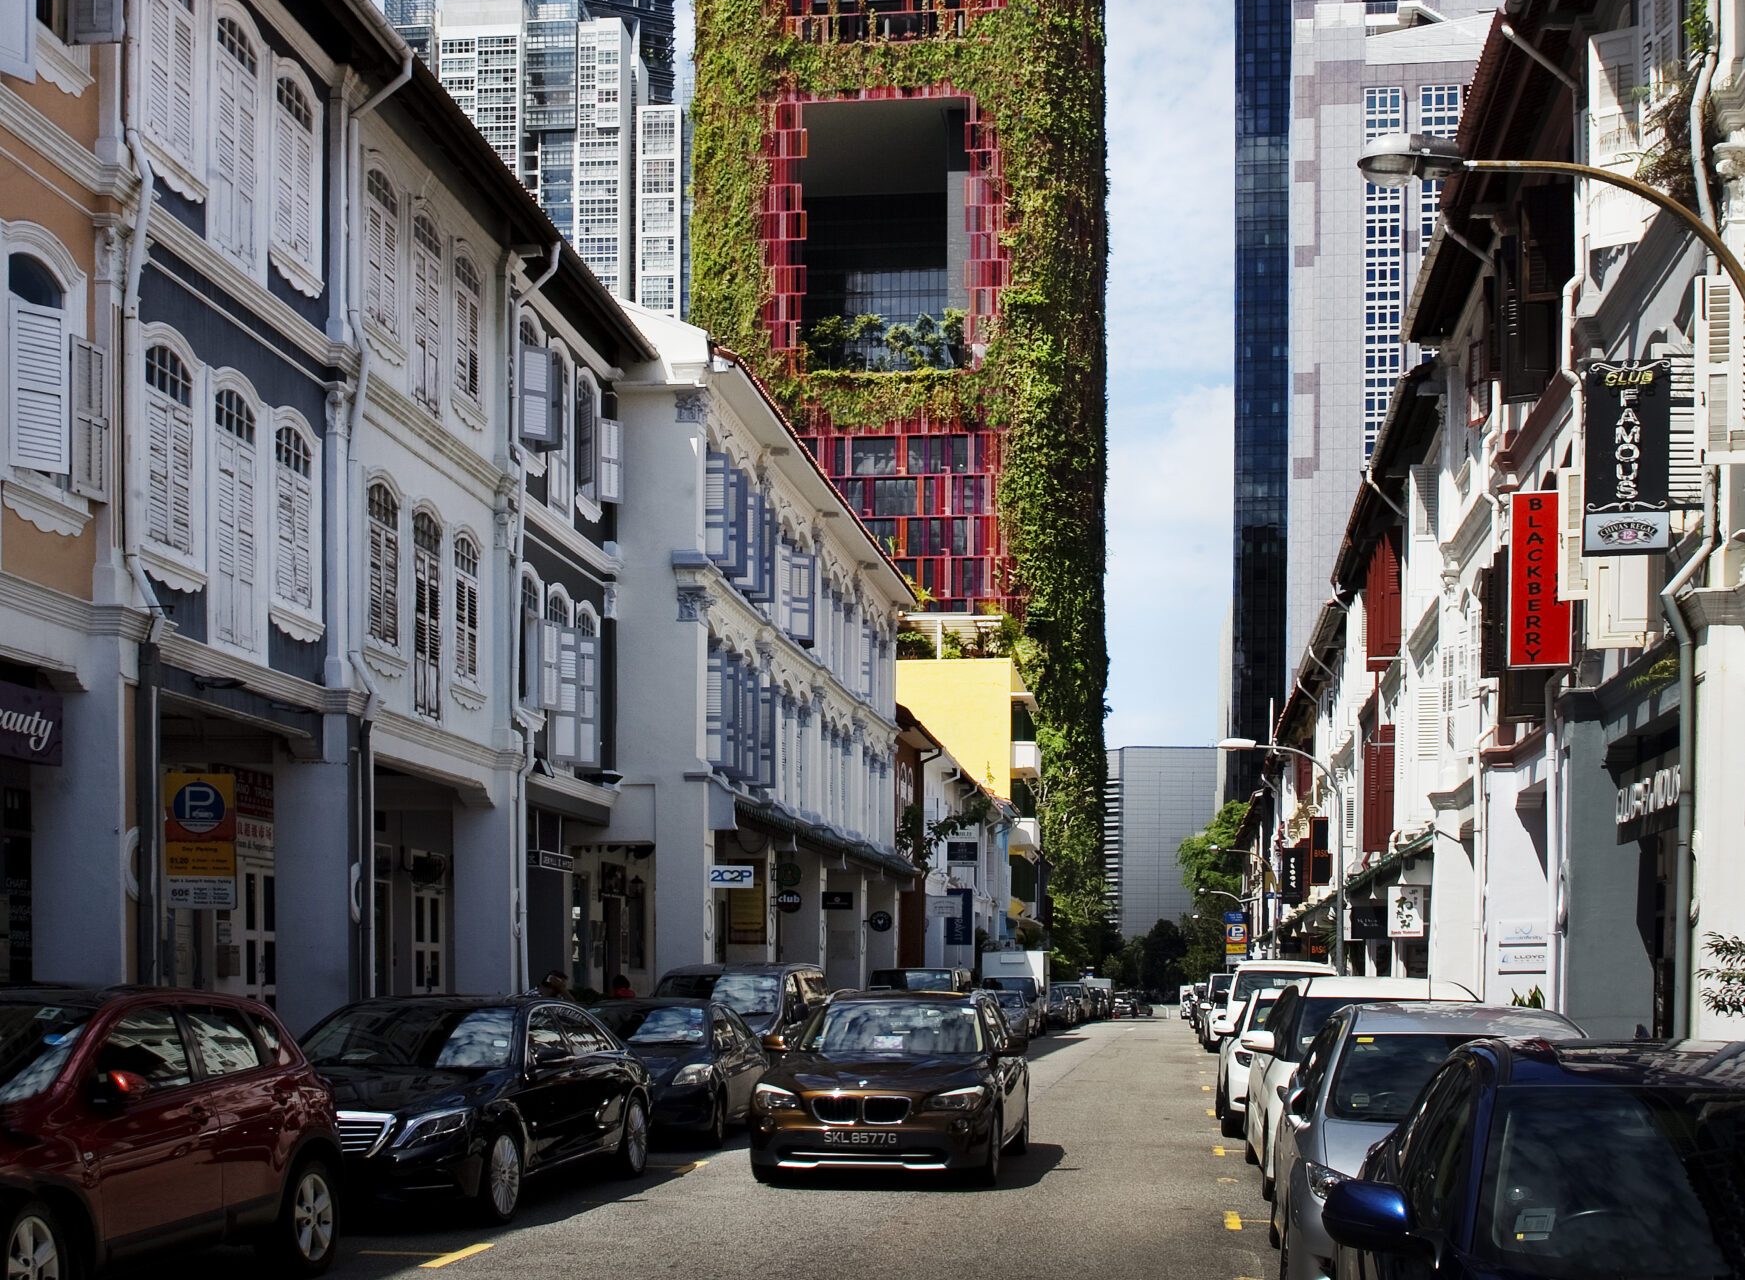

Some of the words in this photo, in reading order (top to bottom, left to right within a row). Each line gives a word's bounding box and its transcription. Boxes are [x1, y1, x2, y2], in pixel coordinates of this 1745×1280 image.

[1604, 370, 1654, 387] CLUB
[1614, 388, 1641, 500] FAMOUS
[1600, 522, 1629, 537] CHIVAS
[1630, 522, 1656, 536] REGAL
[1524, 497, 1545, 663] BLACKBERRY
[777, 895, 801, 903] club
